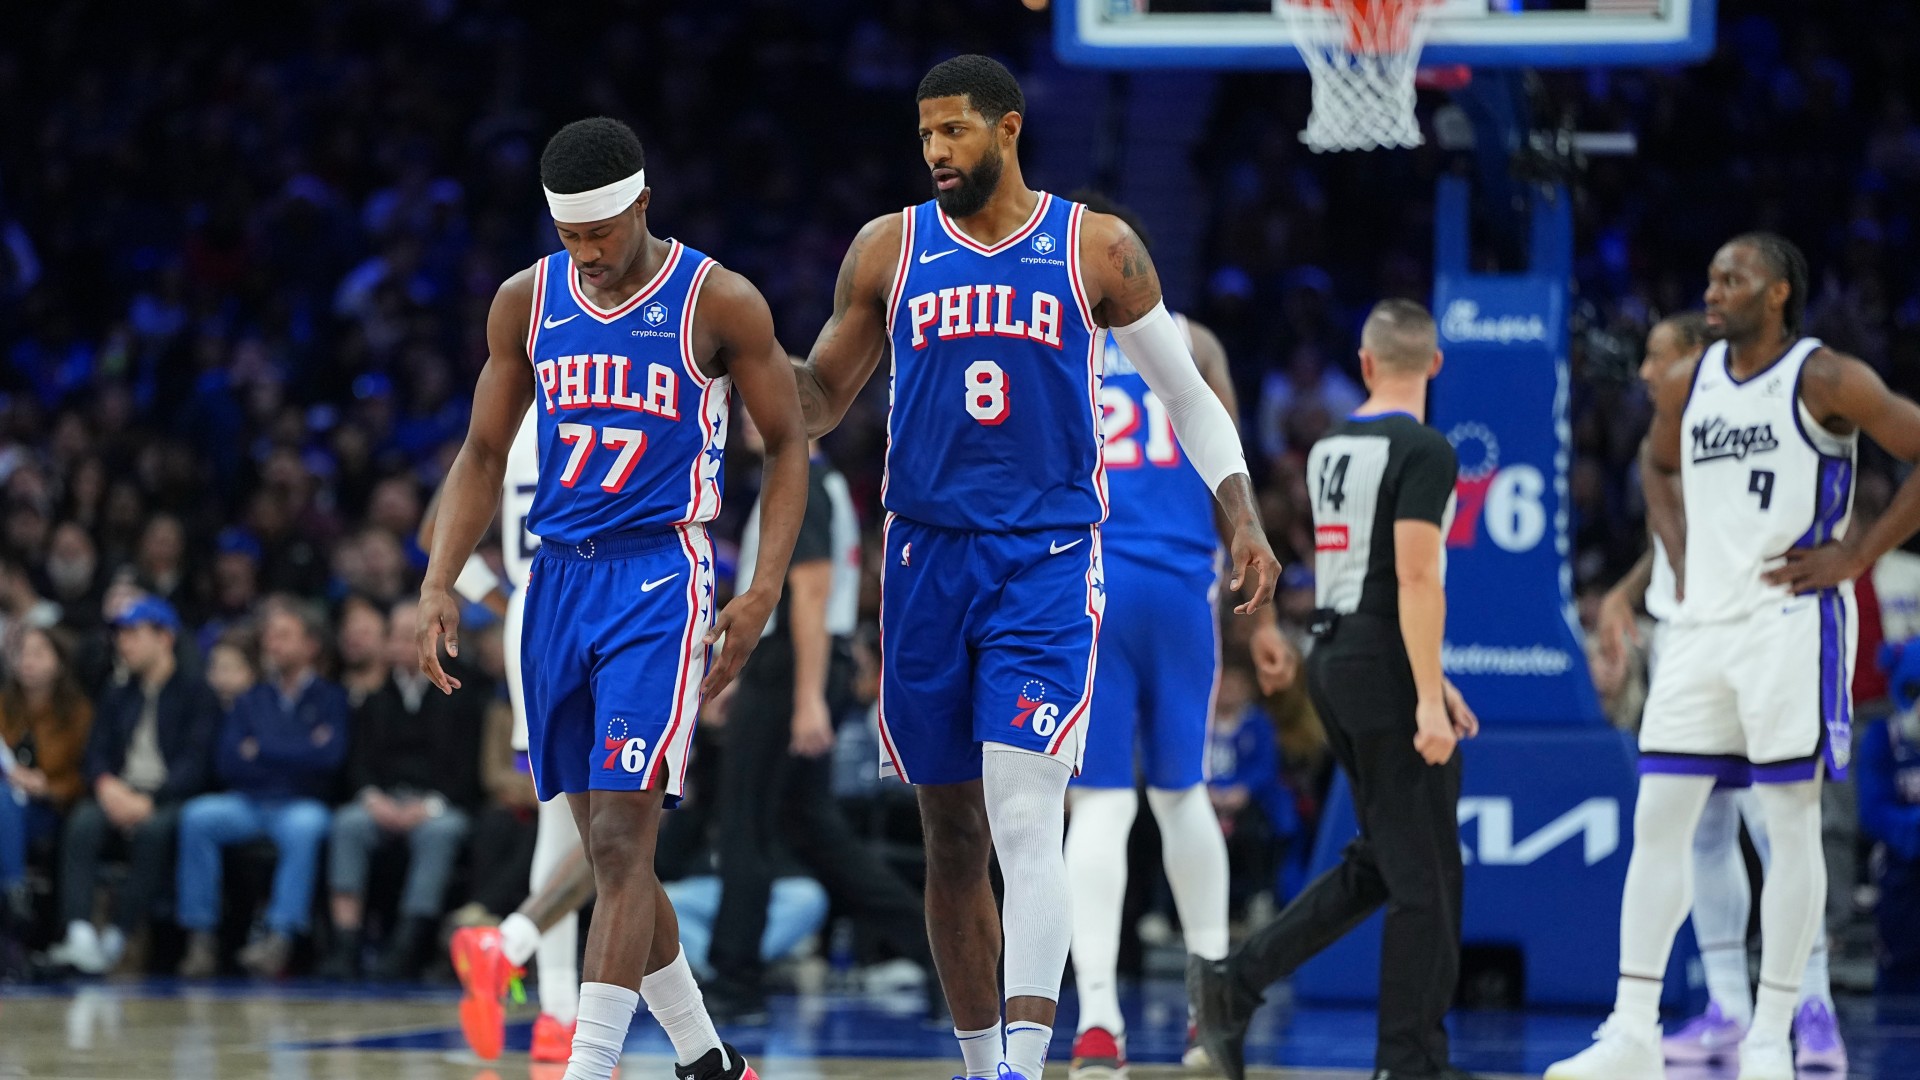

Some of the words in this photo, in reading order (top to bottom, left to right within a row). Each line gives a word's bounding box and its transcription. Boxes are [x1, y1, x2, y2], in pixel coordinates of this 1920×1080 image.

[1020, 257, 1065, 266] crypto.com
[631, 329, 676, 339] crypto.com
[908, 284, 1063, 351] PHILA
[536, 353, 681, 422] PHILA
[964, 360, 1010, 425] 8
[1103, 386, 1180, 468] 21
[1691, 414, 1779, 461] Kings
[557, 423, 648, 494] 77
[1748, 469, 1775, 511] 9
[1010, 693, 1060, 737] 76
[602, 735, 647, 774] 76
